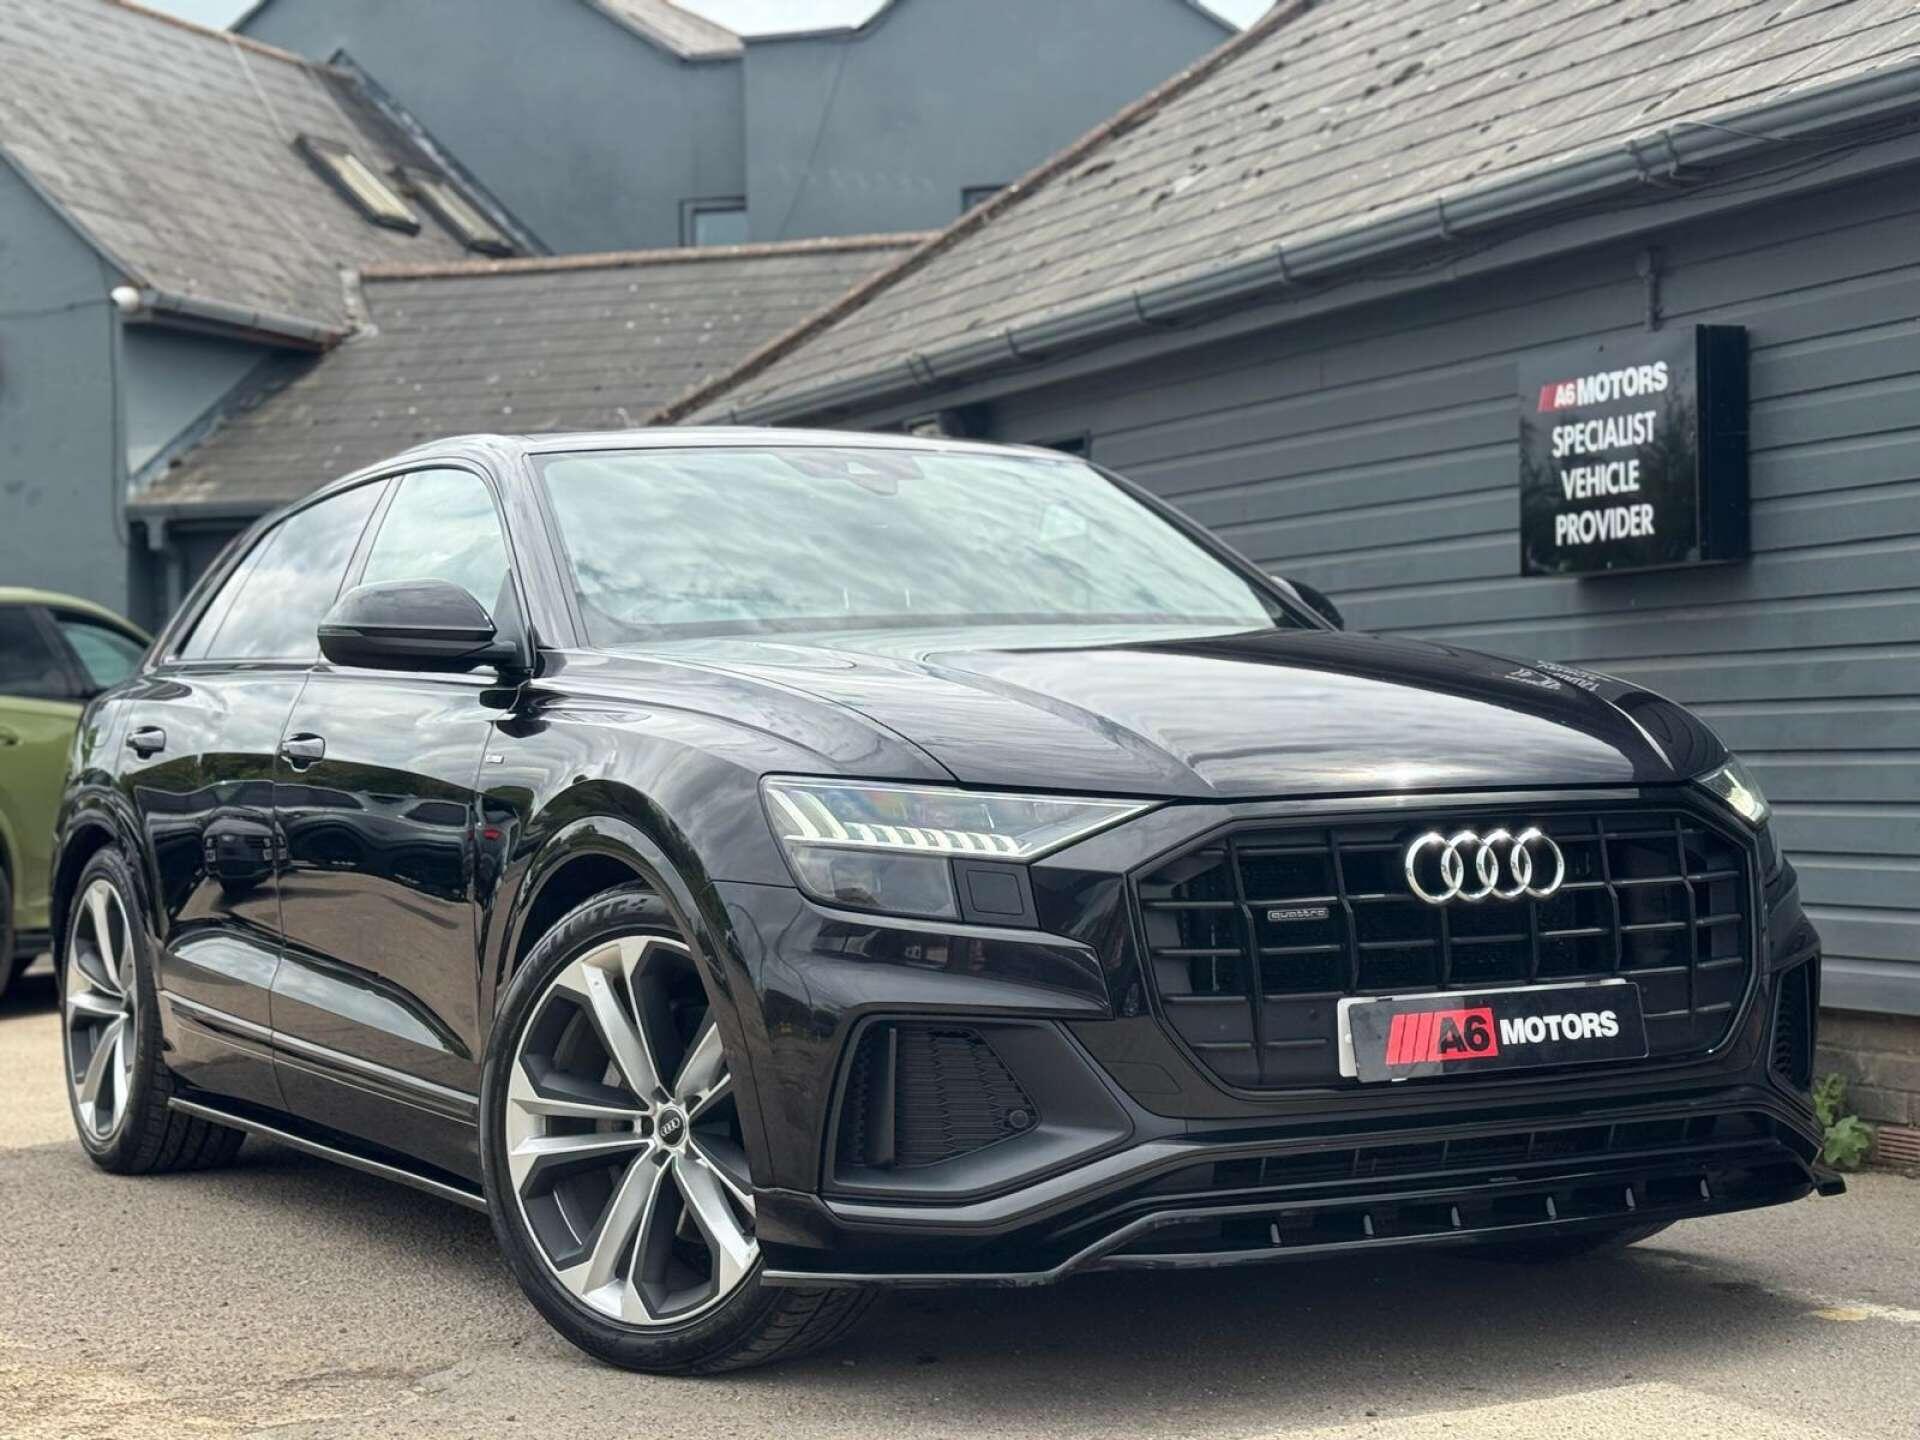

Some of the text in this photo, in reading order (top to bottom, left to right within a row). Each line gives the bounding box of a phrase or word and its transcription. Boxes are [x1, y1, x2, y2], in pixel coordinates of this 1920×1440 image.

[1553, 361, 1668, 408] A6 MOTORS
[1552, 411, 1656, 458] SPECIALIST
[1560, 460, 1640, 500] VEHICLE
[1555, 504, 1655, 546] PROVIDER
[1438, 1010, 1619, 1054] A6 MOTORS
